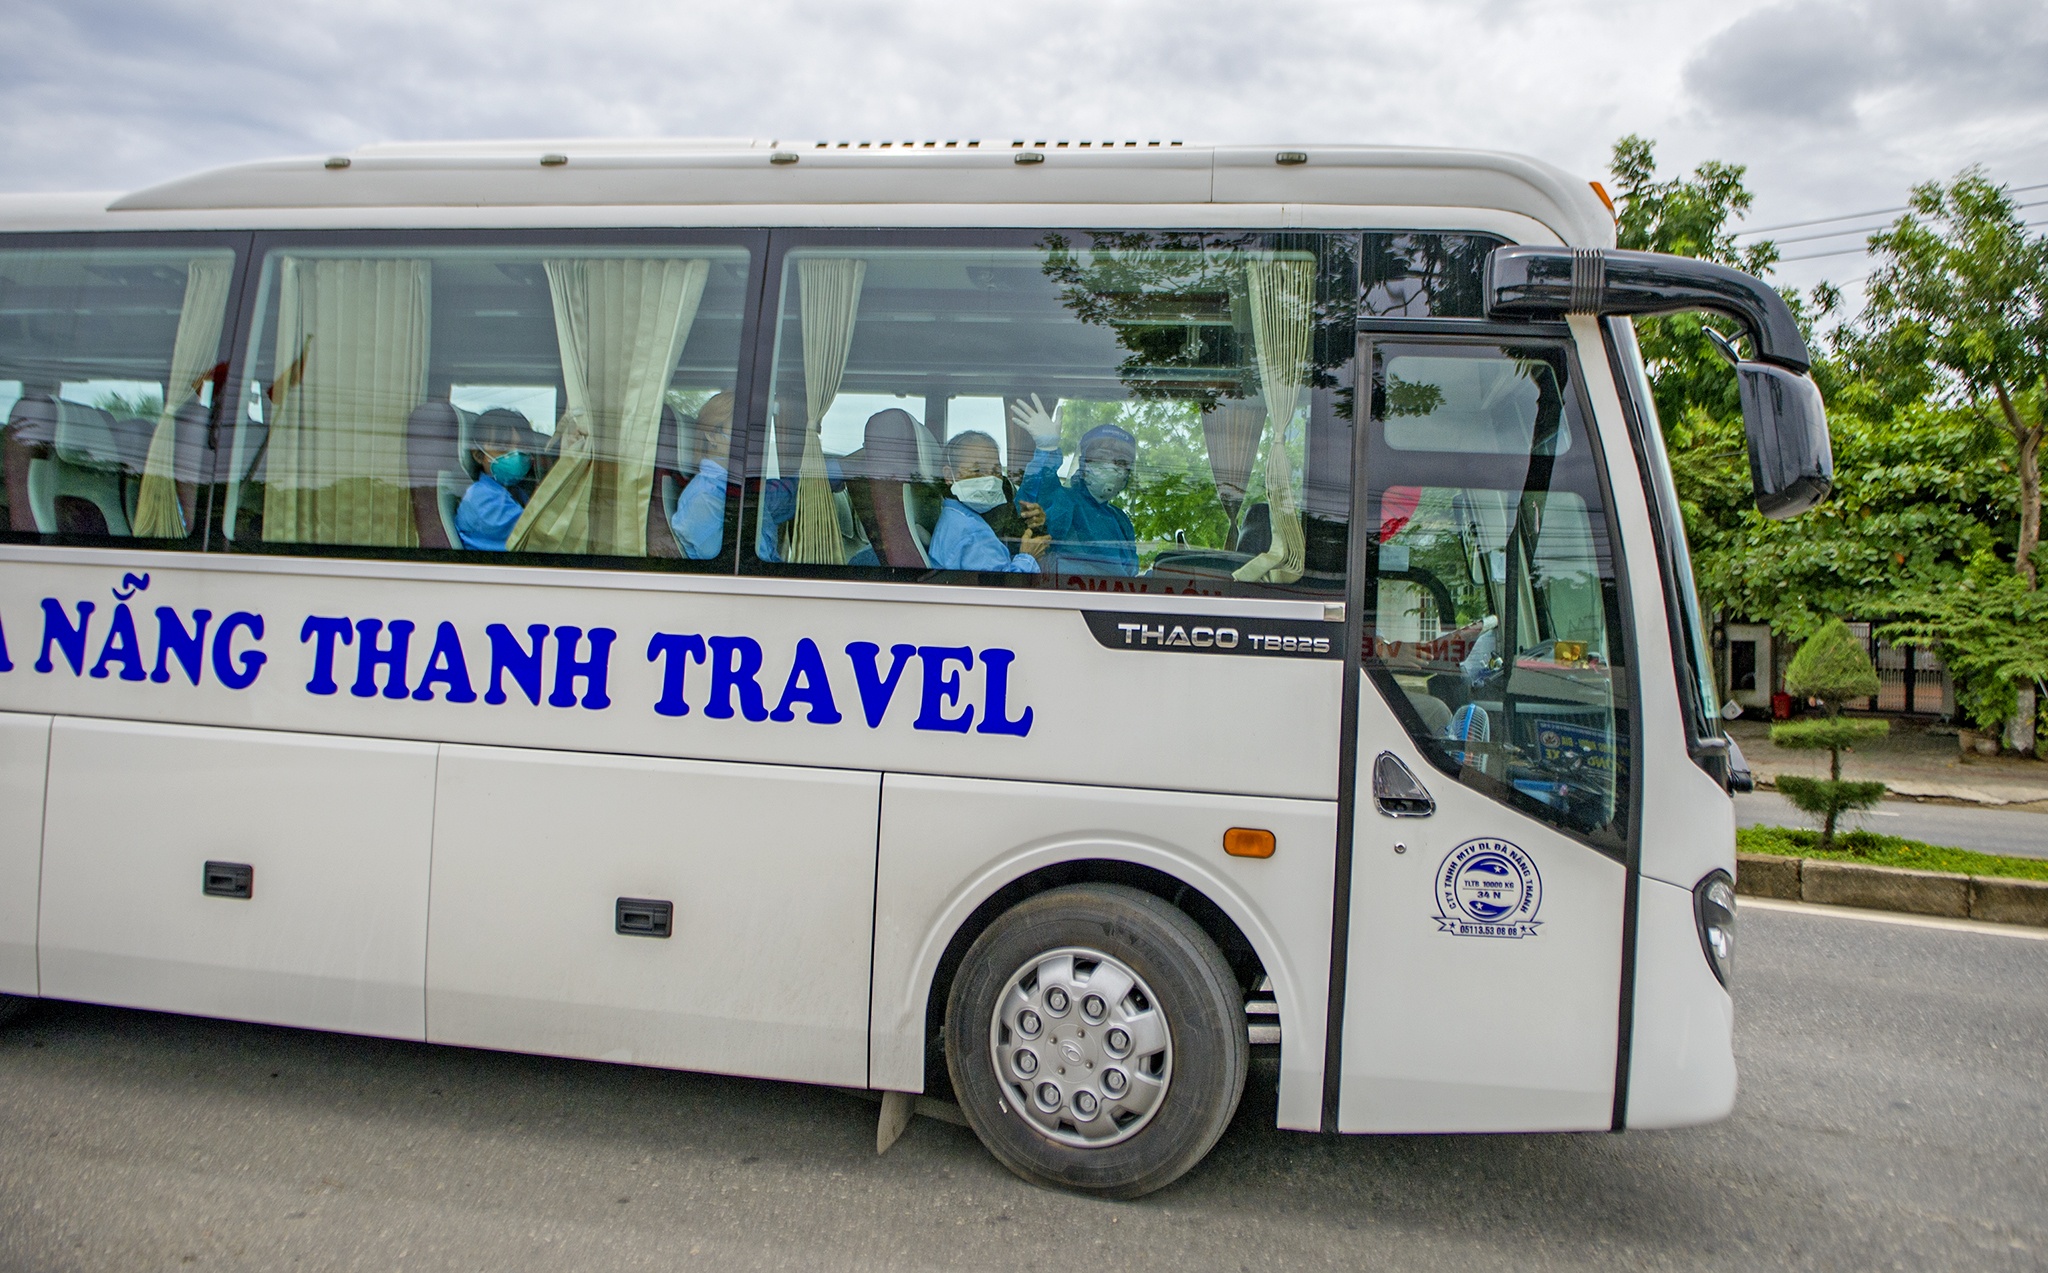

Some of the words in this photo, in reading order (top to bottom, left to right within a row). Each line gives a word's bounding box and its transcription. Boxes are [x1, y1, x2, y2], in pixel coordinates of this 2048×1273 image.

[1117, 623, 1239, 648] THACO
[34, 573, 267, 690] NẴNG
[300, 615, 617, 710] THANH
[646, 632, 1033, 737] TRAVEL
[1456, 845, 1476, 862] MTV
[1478, 842, 1491, 850] DL
[1444, 861, 1458, 887] TNHH
[1504, 881, 1515, 889] KG
[1444, 891, 1457, 910] CTY
[1477, 890, 1490, 899] 34
[1493, 891, 1502, 899] N
[1520, 879, 1533, 914] THANH
[1496, 927, 1506, 936] 08
[1508, 927, 1518, 936] 08
